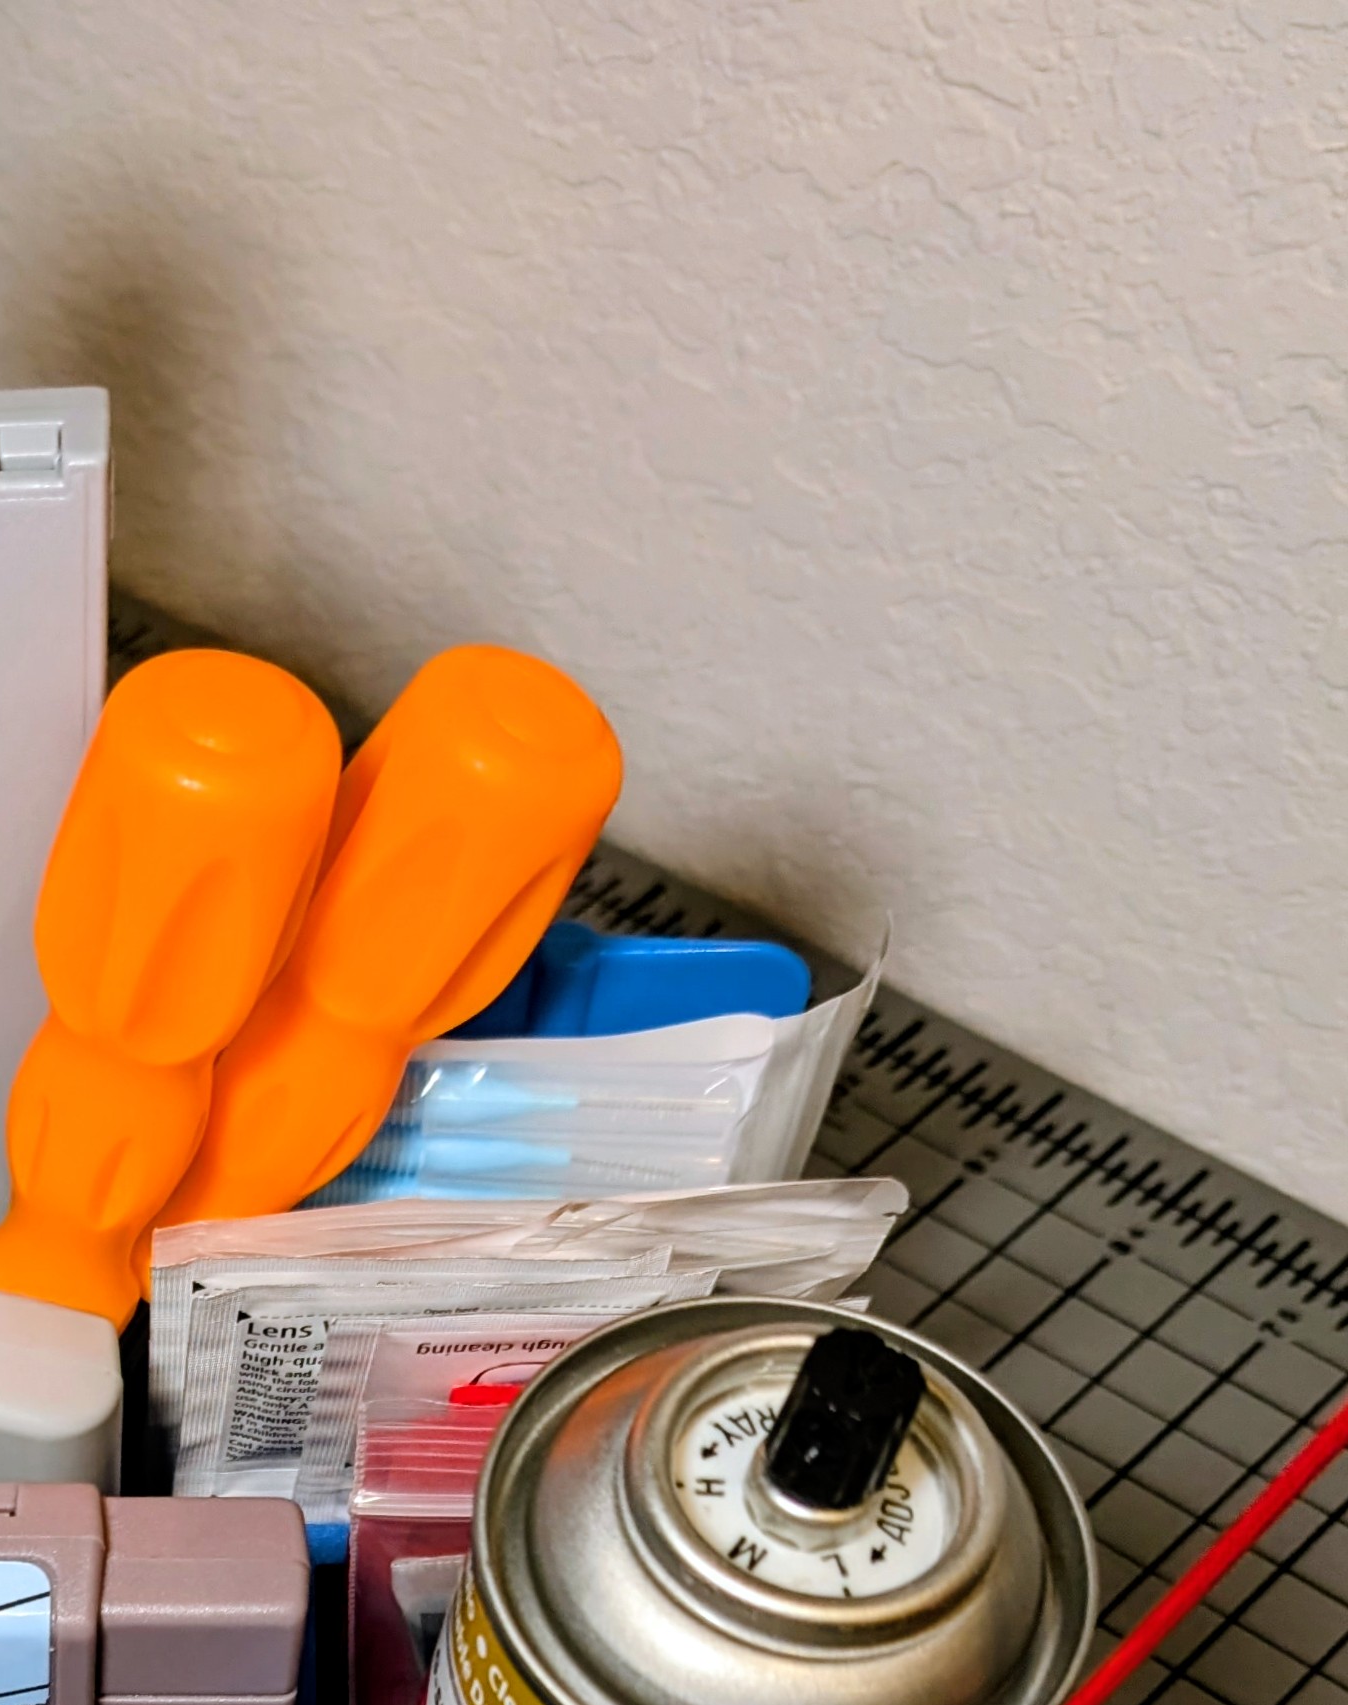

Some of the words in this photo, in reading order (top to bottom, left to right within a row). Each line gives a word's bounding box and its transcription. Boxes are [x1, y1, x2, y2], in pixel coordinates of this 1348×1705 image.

[246, 1322, 313, 1339] Lens
[243, 1338, 308, 1353] Gentle
[415, 1340, 516, 1356] cleaning
